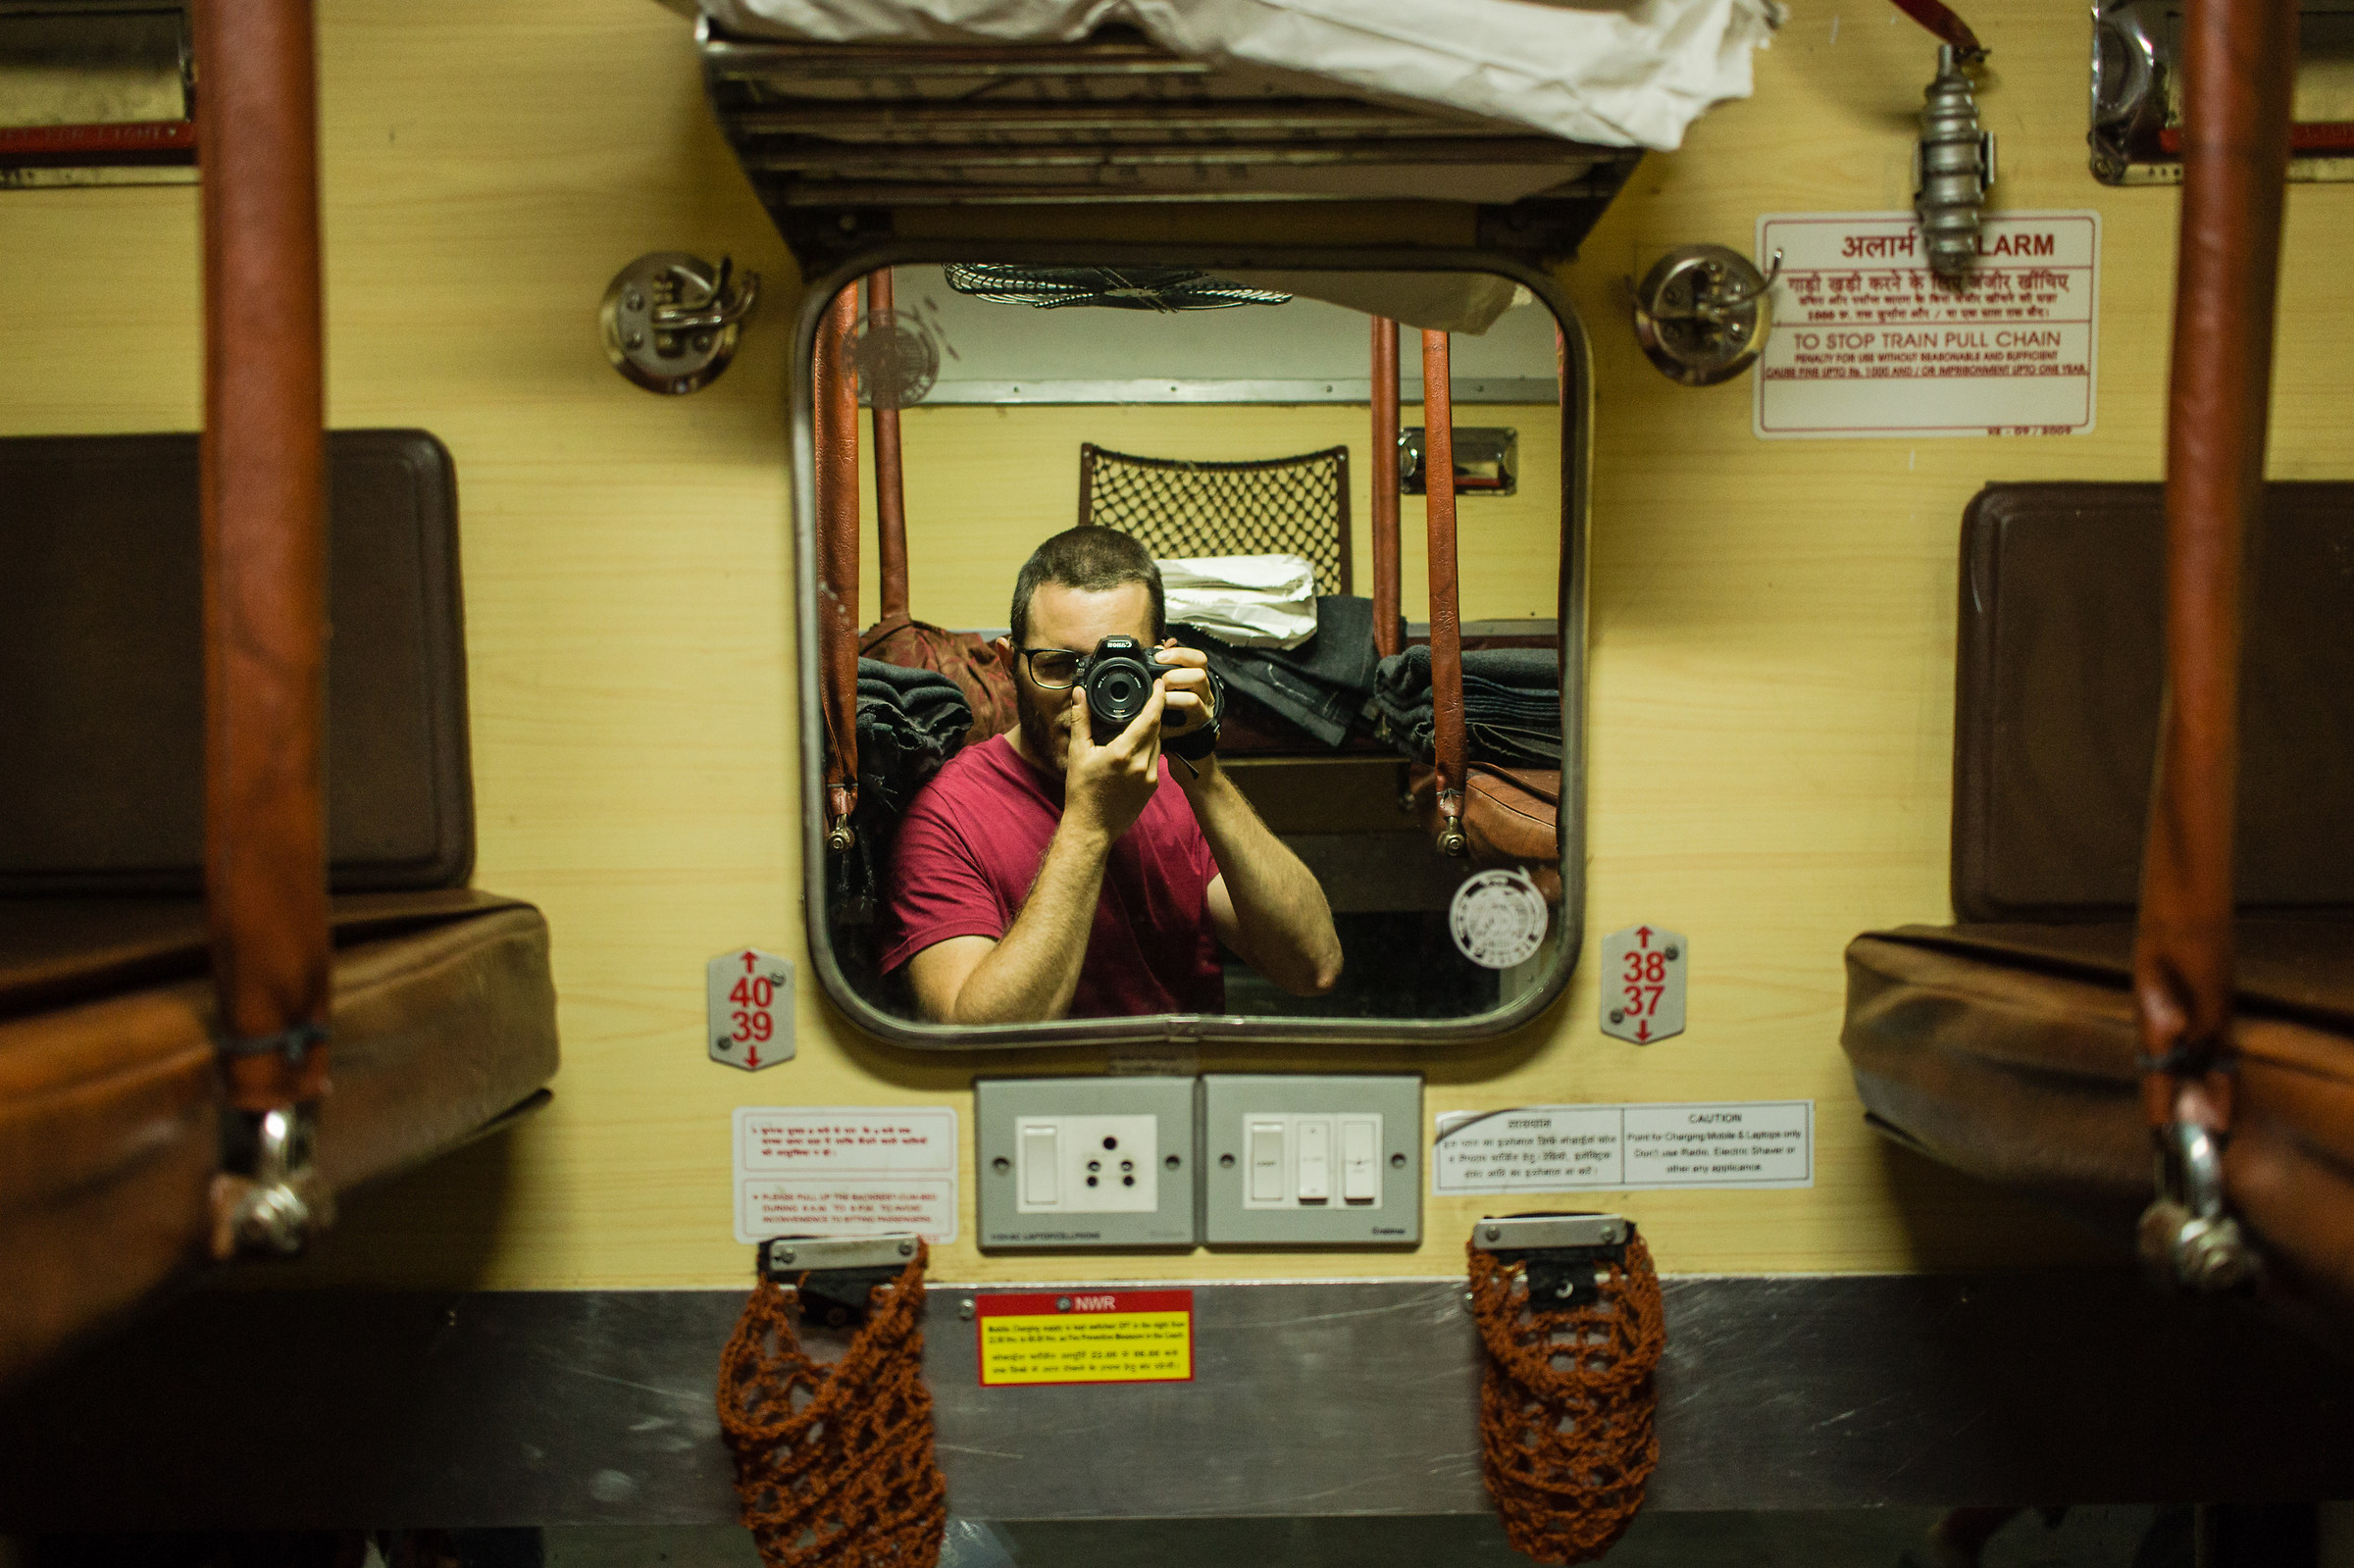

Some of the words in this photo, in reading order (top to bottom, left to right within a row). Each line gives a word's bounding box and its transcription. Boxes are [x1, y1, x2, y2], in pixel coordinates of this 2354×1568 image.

[1842, 227, 1918, 258] अलार्म
[1976, 233, 2055, 256] LARM
[1869, 270, 1901, 291] करने
[1910, 270, 1924, 290] के
[1794, 333, 1820, 350] TO
[1826, 332, 1875, 349] STOP
[1882, 332, 1938, 349] TRAIN
[1945, 331, 1989, 348] PULL
[1995, 330, 2061, 347] CHAIN
[1878, 353, 1918, 362] WITHOUT
[1983, 352, 2004, 361] AND
[1623, 951, 1665, 983] 38
[729, 976, 774, 1008] 40
[1623, 986, 1665, 1016] 37
[732, 1011, 774, 1042] 39
[1688, 1113, 1742, 1124] CAUTION
[1666, 1133, 1705, 1142] Charging
[1075, 1296, 1115, 1310] NWR
